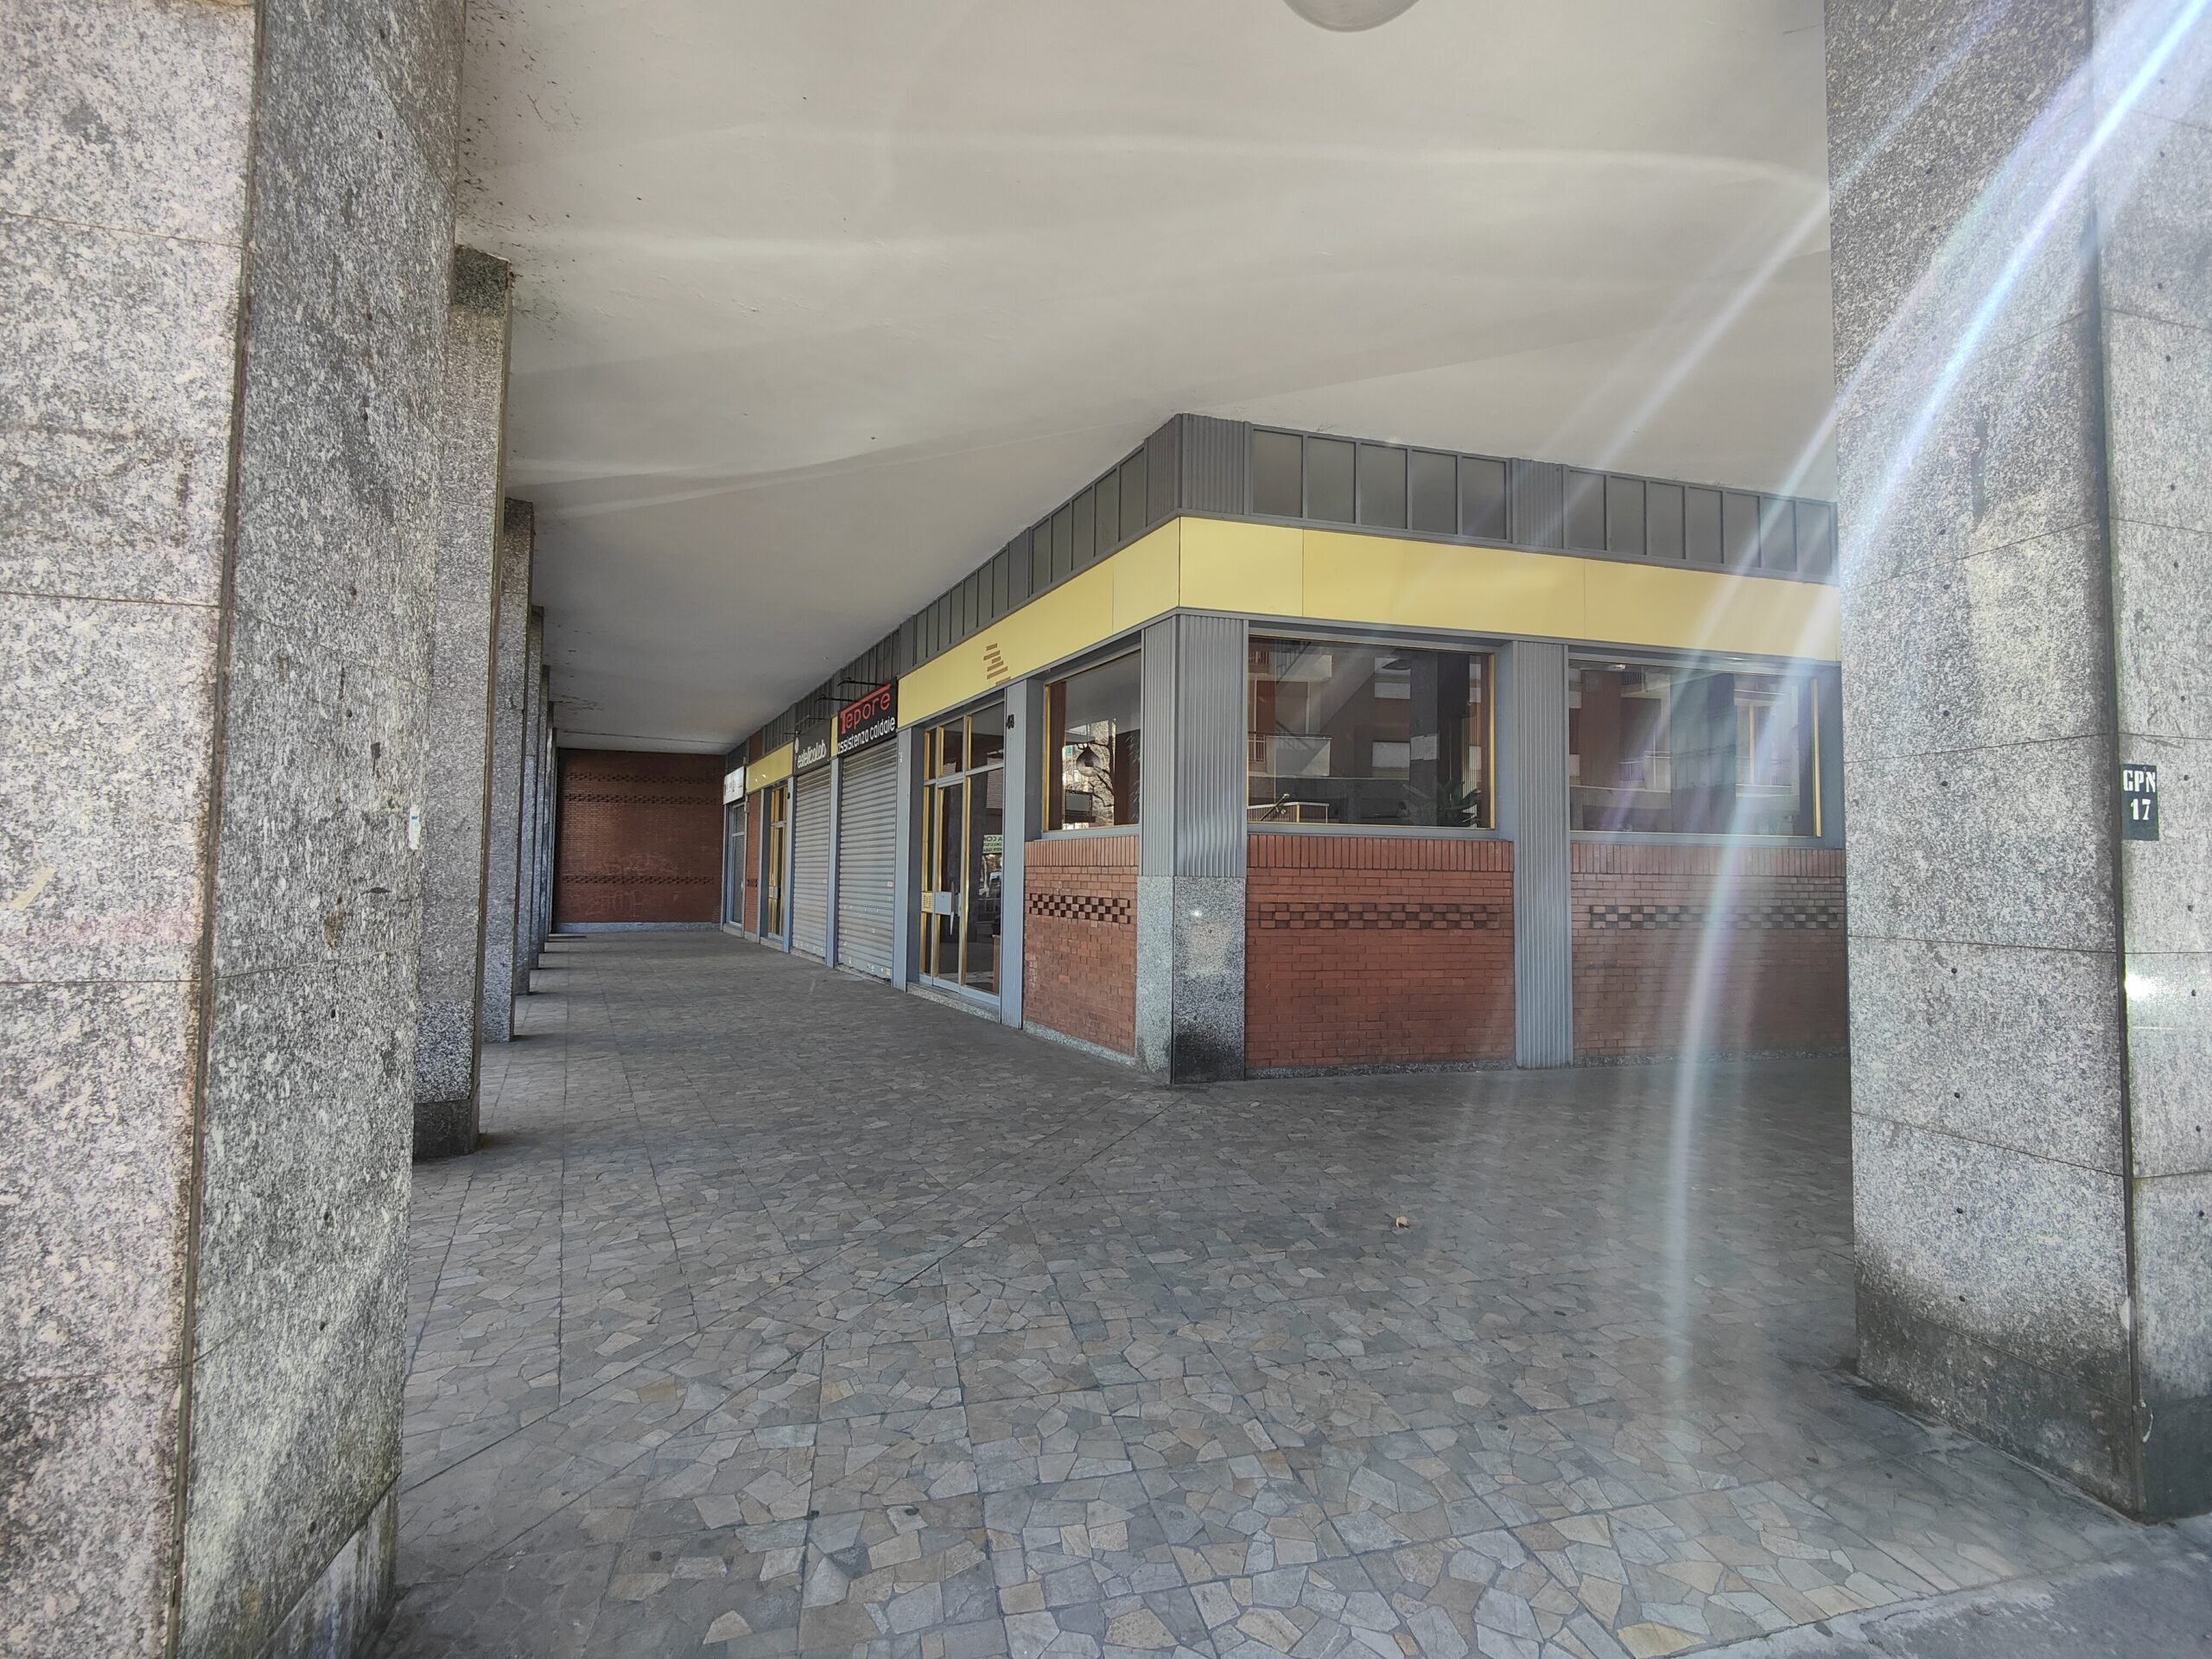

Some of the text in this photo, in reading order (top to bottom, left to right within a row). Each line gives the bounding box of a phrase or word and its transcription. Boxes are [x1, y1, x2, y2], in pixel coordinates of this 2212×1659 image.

[840, 683, 892, 734] Tepore
[837, 716, 895, 754] assistenza caldaie
[2131, 798, 2151, 820] 17
